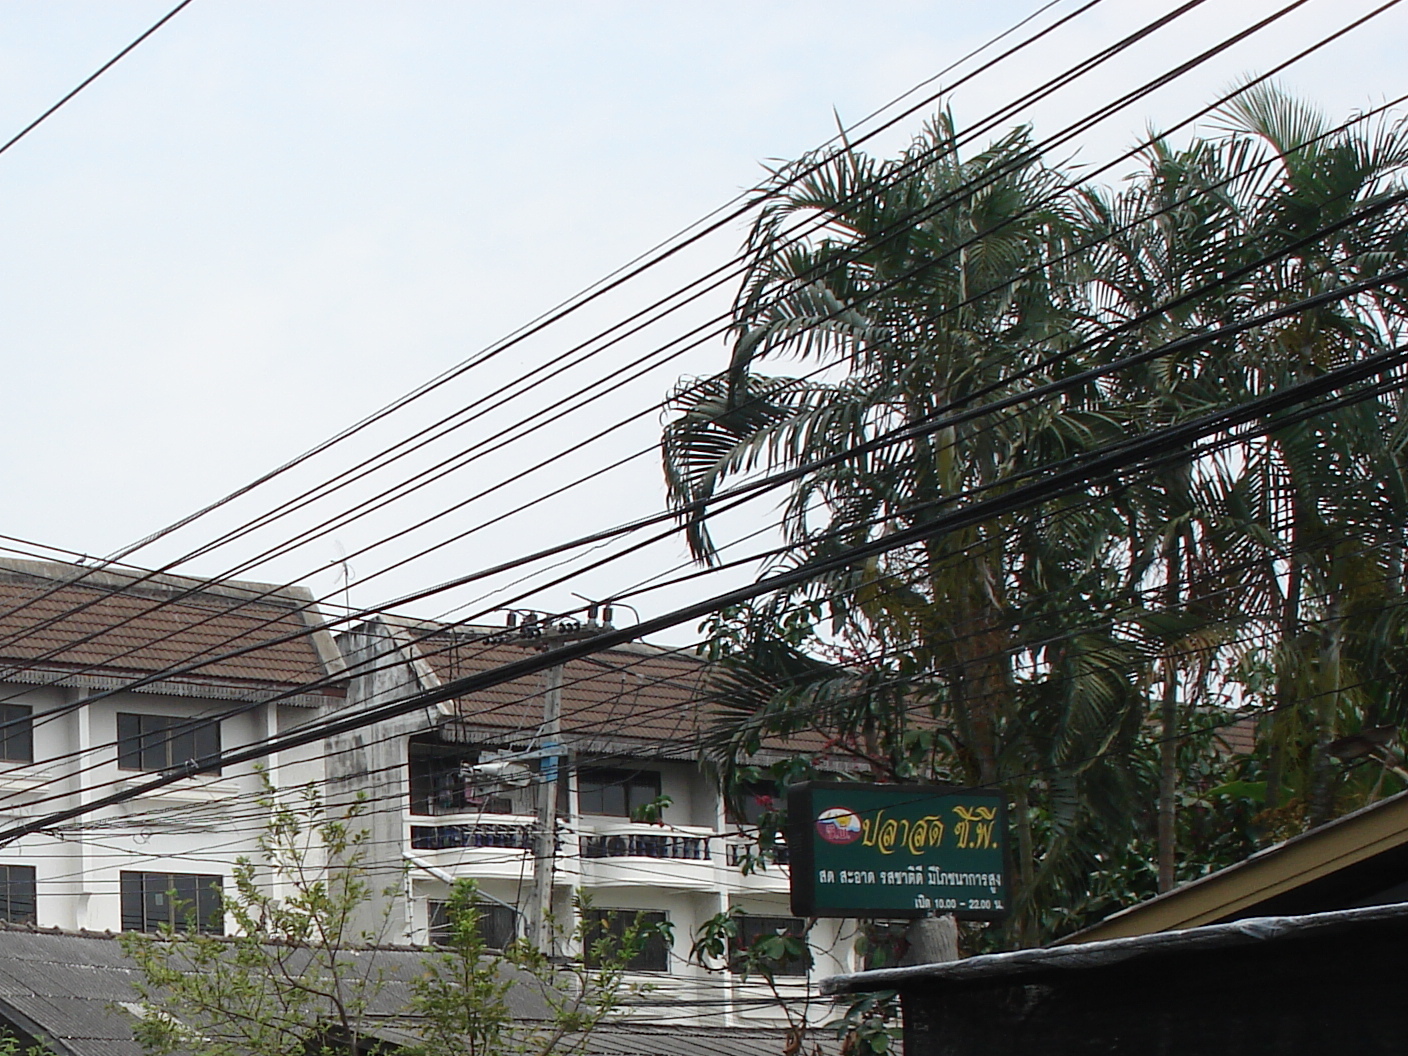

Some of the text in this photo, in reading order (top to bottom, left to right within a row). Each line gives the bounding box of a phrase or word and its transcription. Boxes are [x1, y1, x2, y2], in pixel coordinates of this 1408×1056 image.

[862, 809, 944, 855] ปลาสด
[819, 869, 835, 883] สด
[840, 870, 875, 884] สะอาด
[935, 899, 957, 909] 10.00
[969, 899, 991, 910] 22.00
